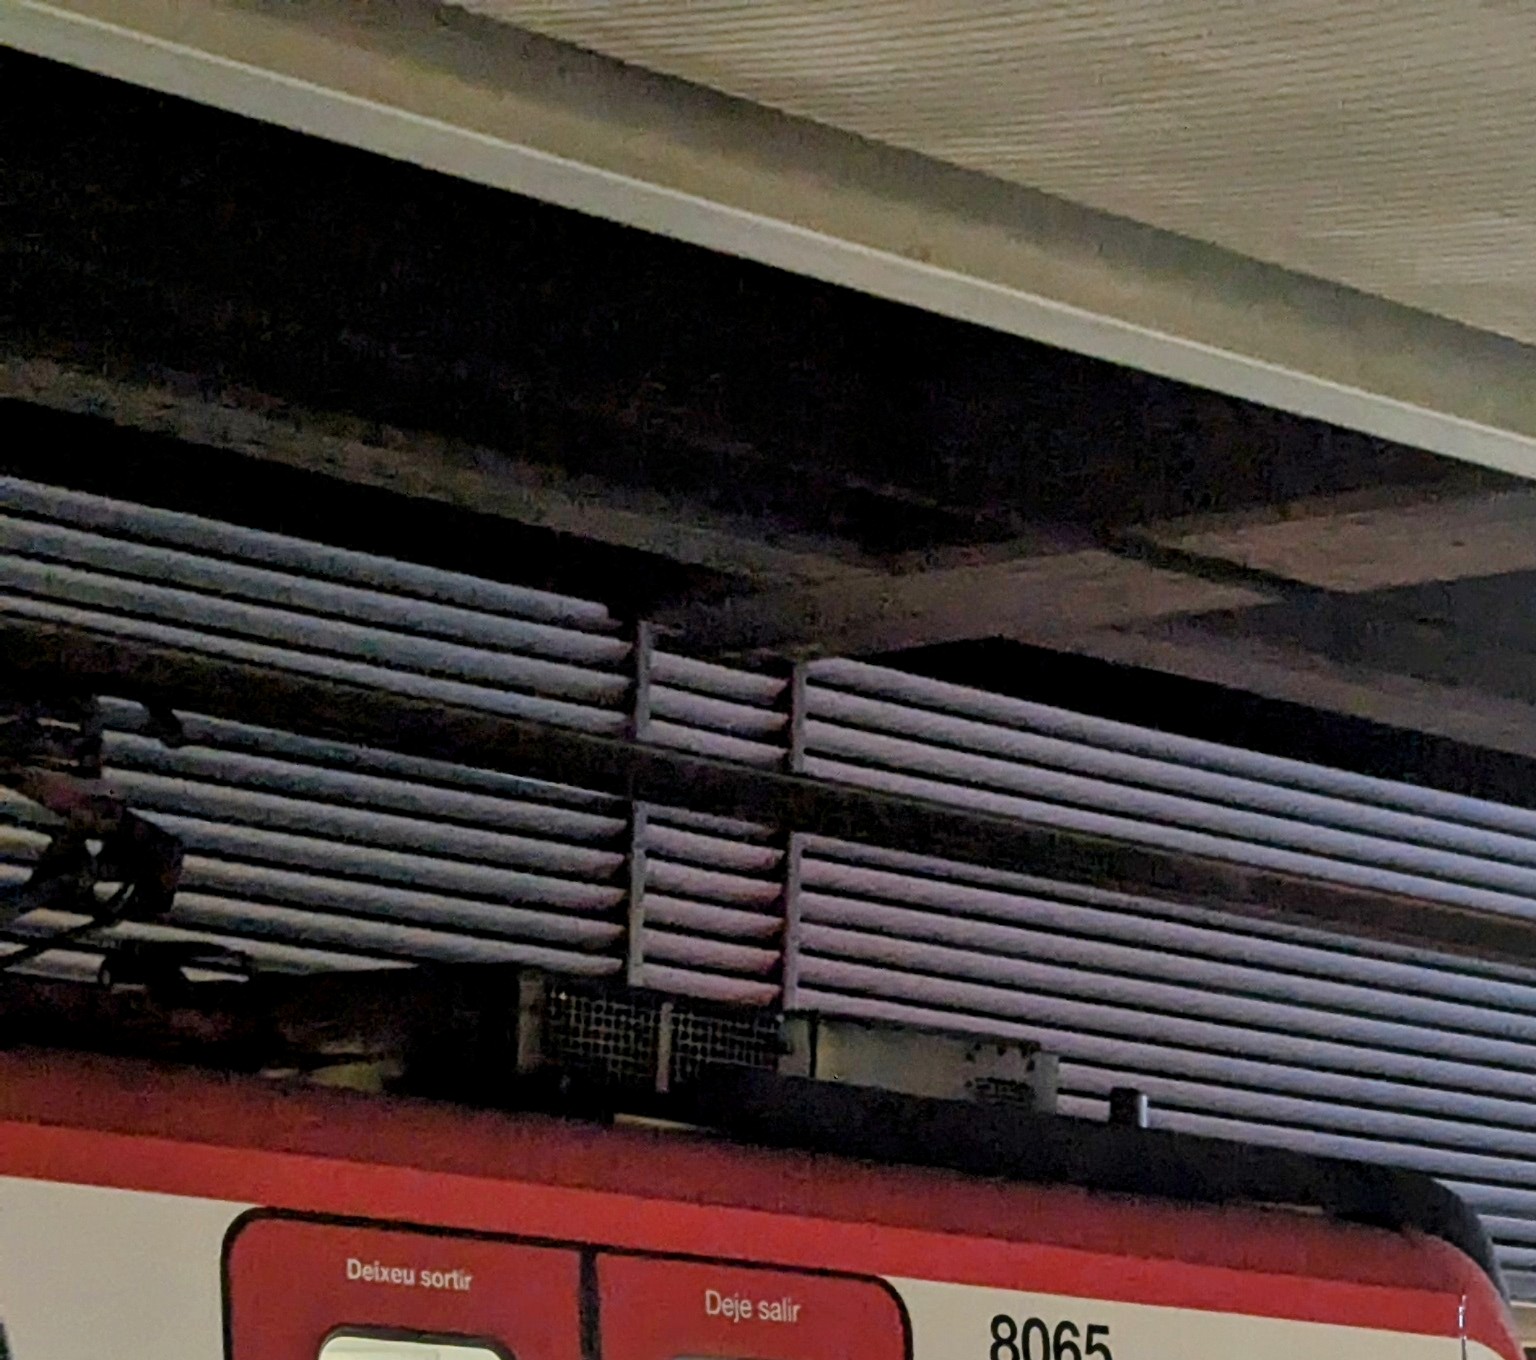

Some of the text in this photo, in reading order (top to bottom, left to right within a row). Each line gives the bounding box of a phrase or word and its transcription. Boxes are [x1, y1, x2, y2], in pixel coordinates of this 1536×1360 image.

[346, 1258, 473, 1291] Deixeu sortir
[705, 1288, 801, 1323] Deje salir
